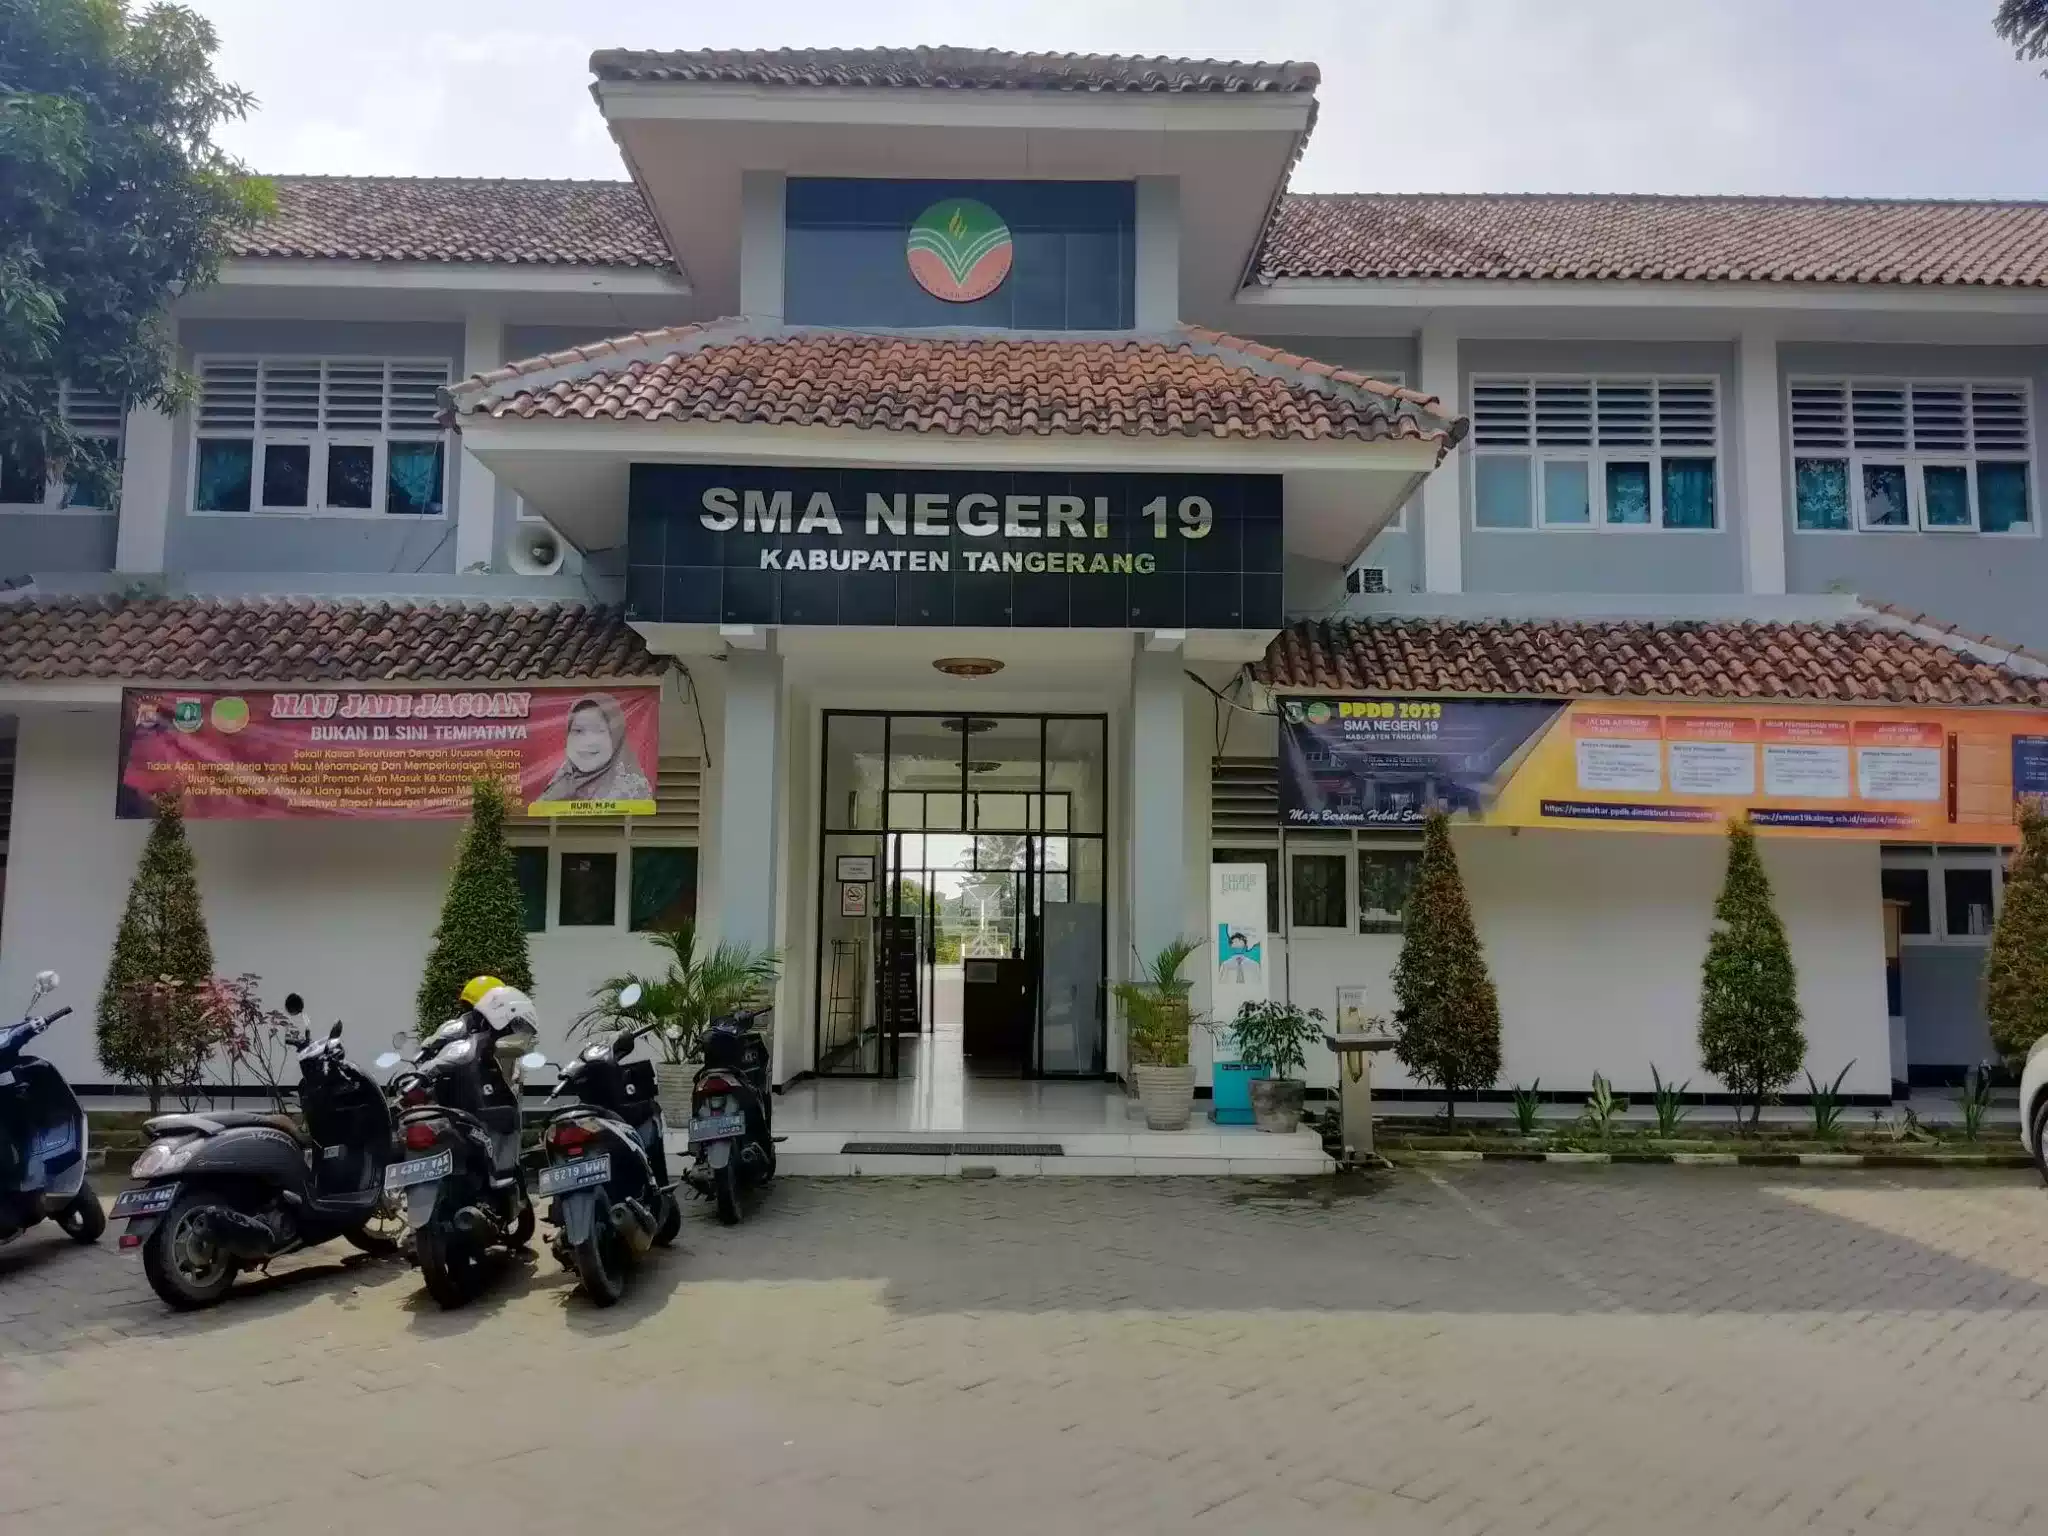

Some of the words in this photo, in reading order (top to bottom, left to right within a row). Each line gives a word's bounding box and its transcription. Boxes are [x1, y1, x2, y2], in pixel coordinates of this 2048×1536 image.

[700, 487, 843, 536] SMA
[865, 493, 1109, 539] NEGERI
[1140, 496, 1213, 539] 19
[759, 549, 949, 573] KABUPATEN
[963, 551, 1156, 575] TANGERANG
[271, 693, 338, 718] MAU
[341, 693, 413, 718] JADI
[414, 692, 532, 718] JAGOAN
[1339, 702, 1395, 718] PPDB
[1398, 702, 1441, 719] 2023
[311, 725, 368, 741] BUKAN
[373, 725, 390, 740] DI
[395, 725, 428, 740] SINI
[434, 724, 527, 740] TEMPATNYA
[1343, 720, 1371, 731] SMA
[1374, 720, 1421, 732] NEGERI
[1424, 721, 1439, 732] 19
[408, 749, 447, 760] Dengan
[174, 761, 195, 771] Ada
[197, 761, 234, 773] Tempat
[264, 762, 288, 773] Yang
[291, 762, 312, 771] Mau
[315, 762, 379, 773] Menampung
[381, 761, 401, 771] Dan
[299, 774, 320, 783] Jadi
[323, 774, 360, 783] Preman
[363, 774, 387, 783] Akan
[390, 774, 421, 783] Masuk
[377, 786, 401, 797] Yang
[428, 786, 454, 795] Akan
[1289, 808, 1319, 824] Maju
[1321, 809, 1365, 822] Bersama
[1367, 809, 1399, 822] Hebat
